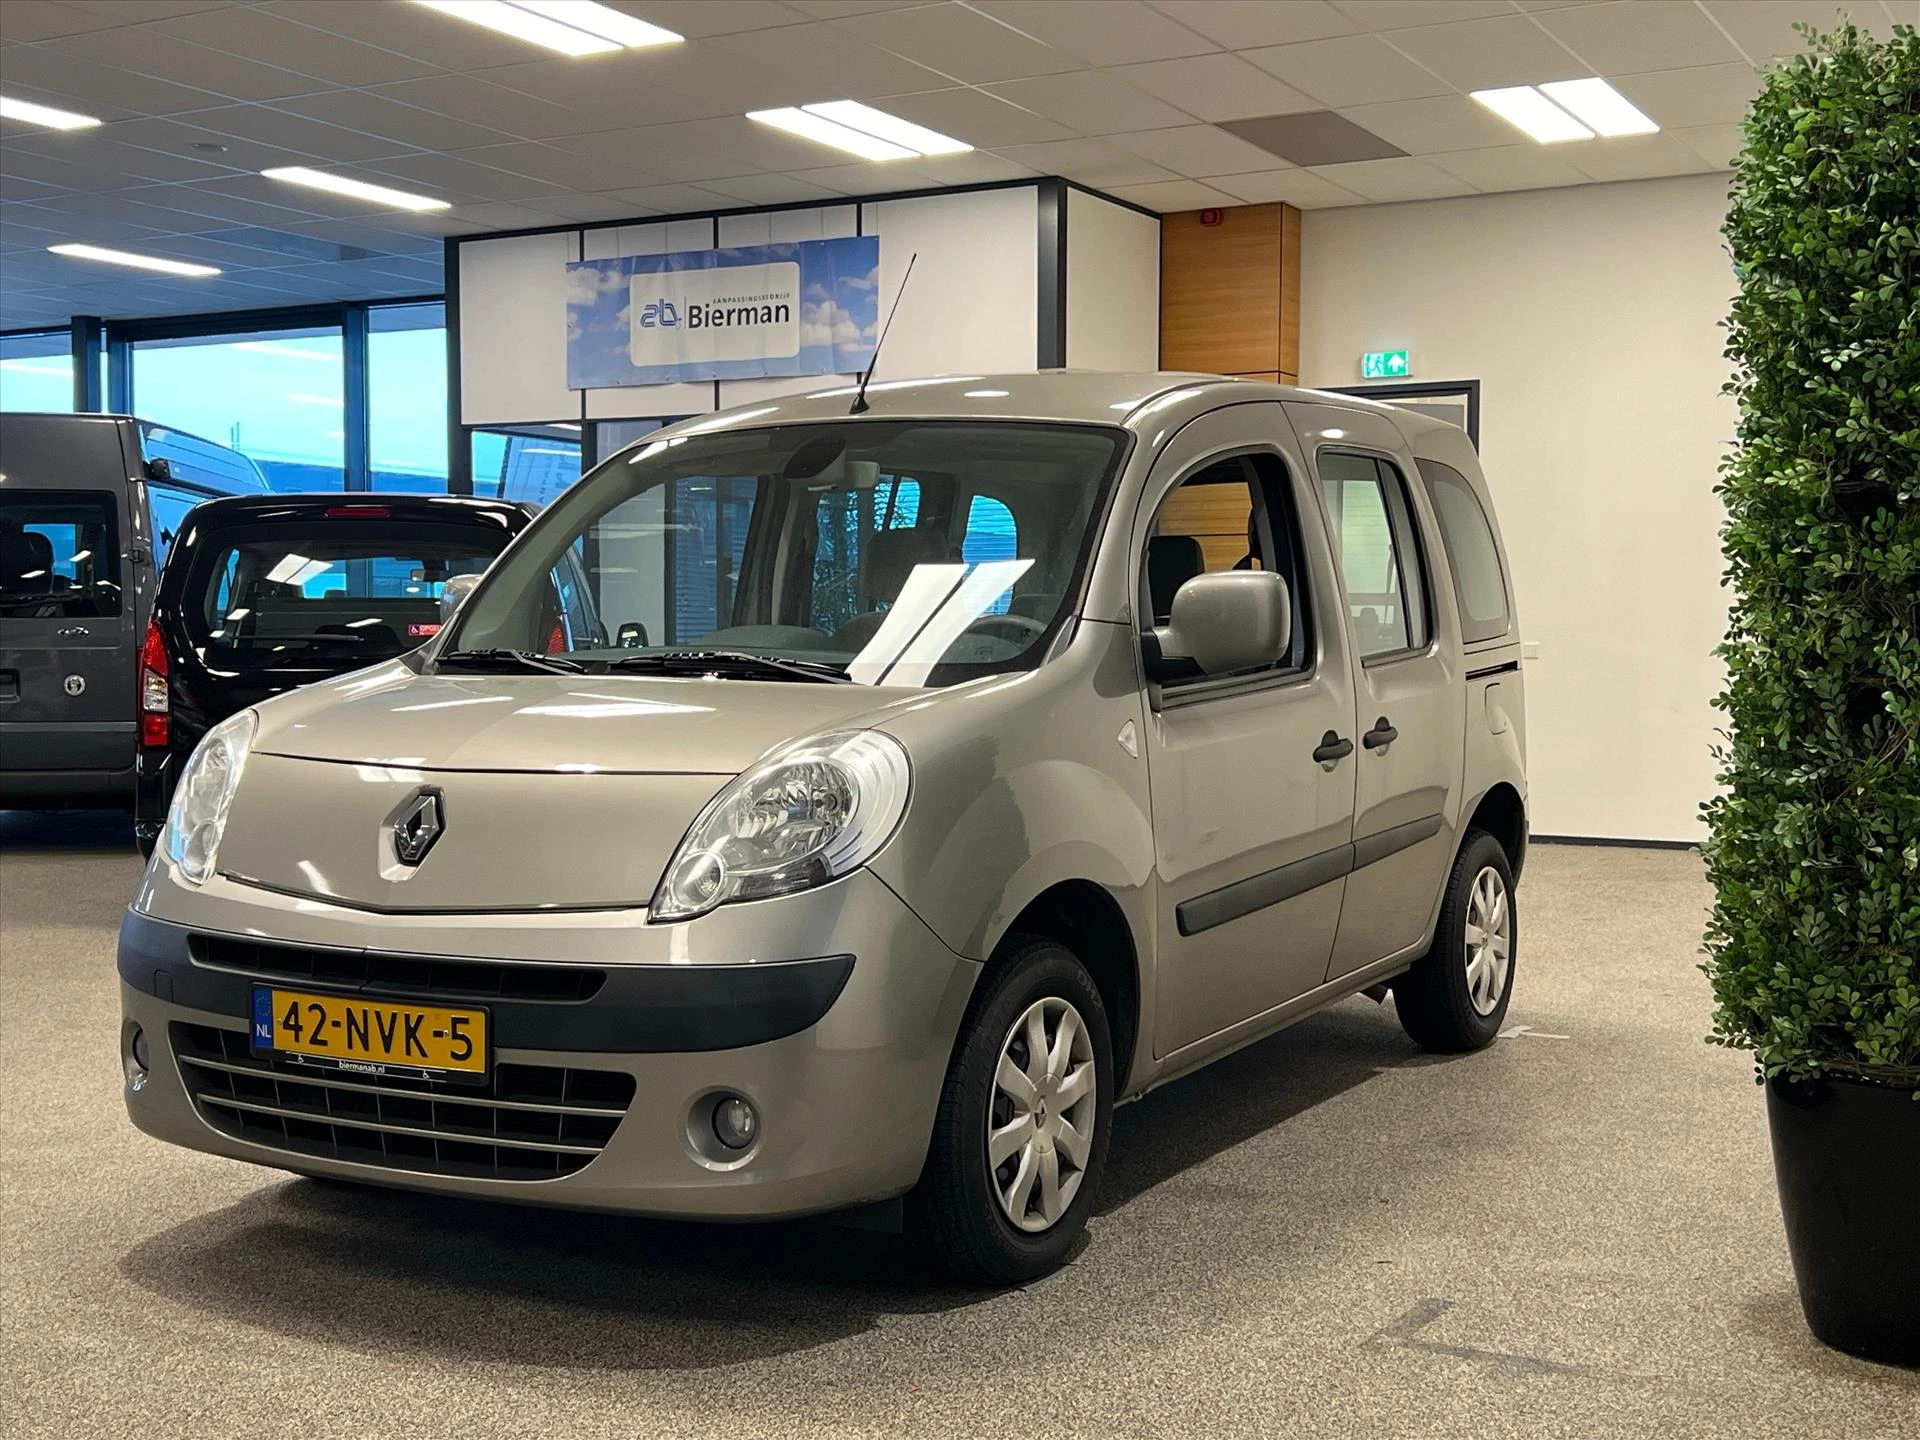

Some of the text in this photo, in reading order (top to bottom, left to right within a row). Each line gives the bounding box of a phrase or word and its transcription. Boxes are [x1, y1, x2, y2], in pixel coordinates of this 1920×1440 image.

[688, 303, 790, 329] Bierman
[256, 1024, 272, 1039] NL
[282, 1000, 473, 1062] 42-NVK-5
[338, 1059, 386, 1074] biermanab.nl
